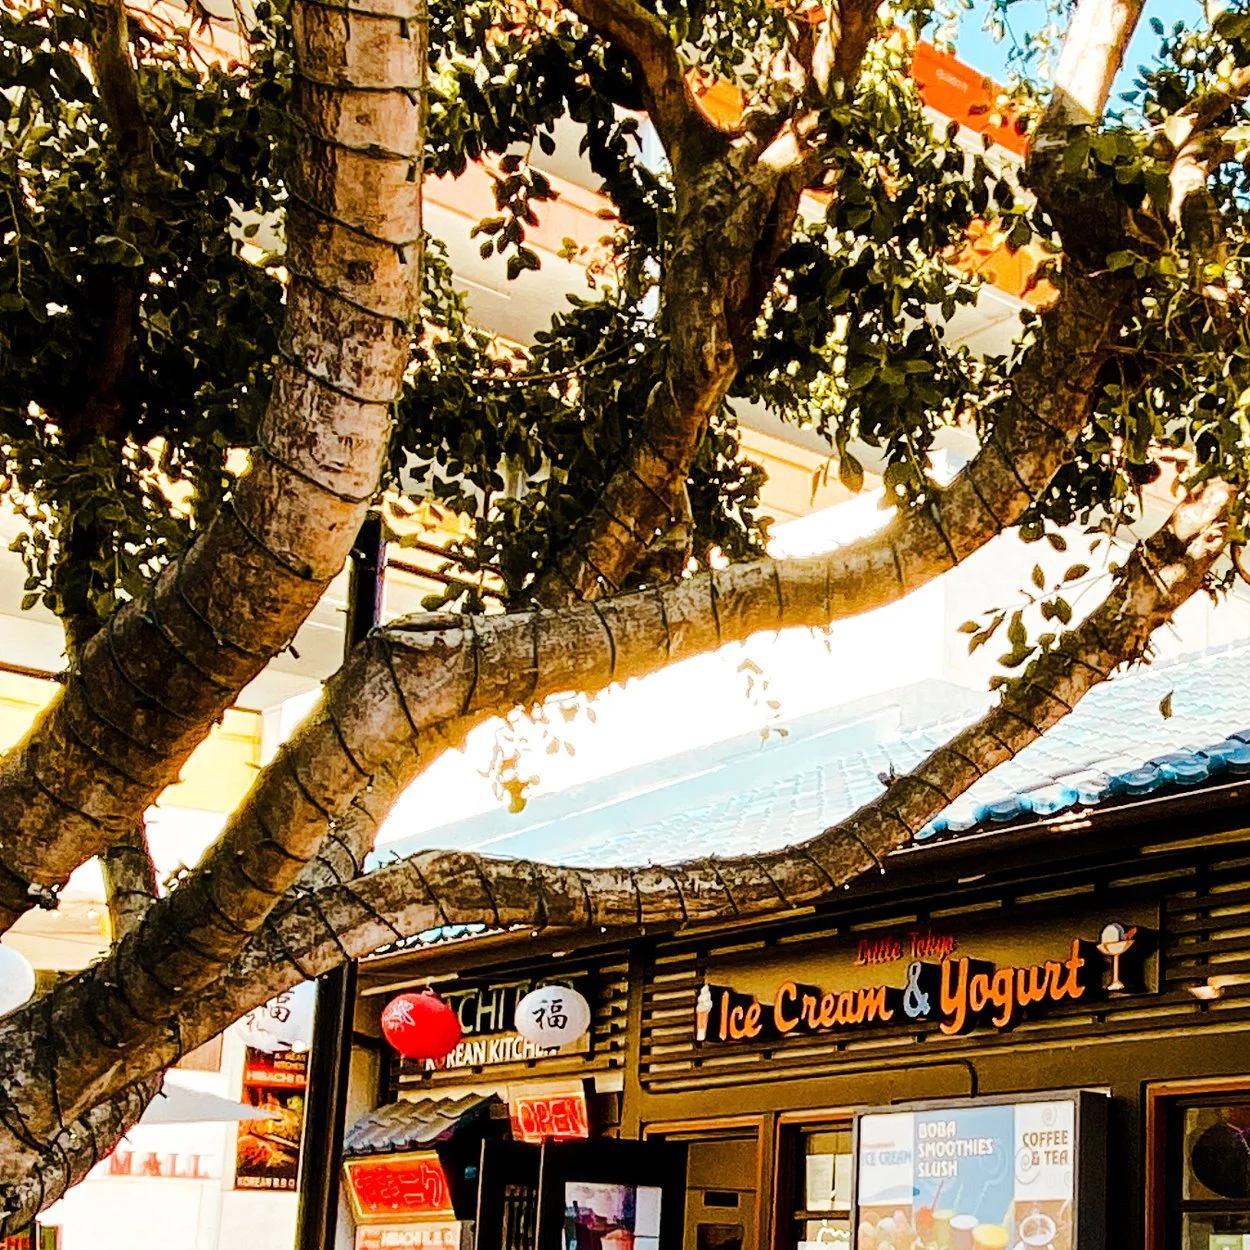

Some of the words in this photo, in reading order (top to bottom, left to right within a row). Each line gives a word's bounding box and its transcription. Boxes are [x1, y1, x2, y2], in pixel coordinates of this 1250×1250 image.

[854, 934, 902, 966] Little
[909, 930, 957, 963] Tokyo
[719, 991, 763, 1041] Ice
[773, 980, 894, 1034] Cream
[902, 961, 931, 1019] &
[939, 938, 1086, 1036] Yogurt
[532, 998, 569, 1030] 福
[489, 1036, 558, 1064] KITCH
[517, 1098, 587, 1136] OPEN
[918, 1120, 957, 1139] BOBA
[917, 1138, 994, 1159] SMOOTHIES
[1022, 1130, 1069, 1148] COFFEE
[107, 1150, 212, 1179] MALL
[917, 1159, 958, 1179] SLUSH
[1045, 1149, 1069, 1166] TEA
